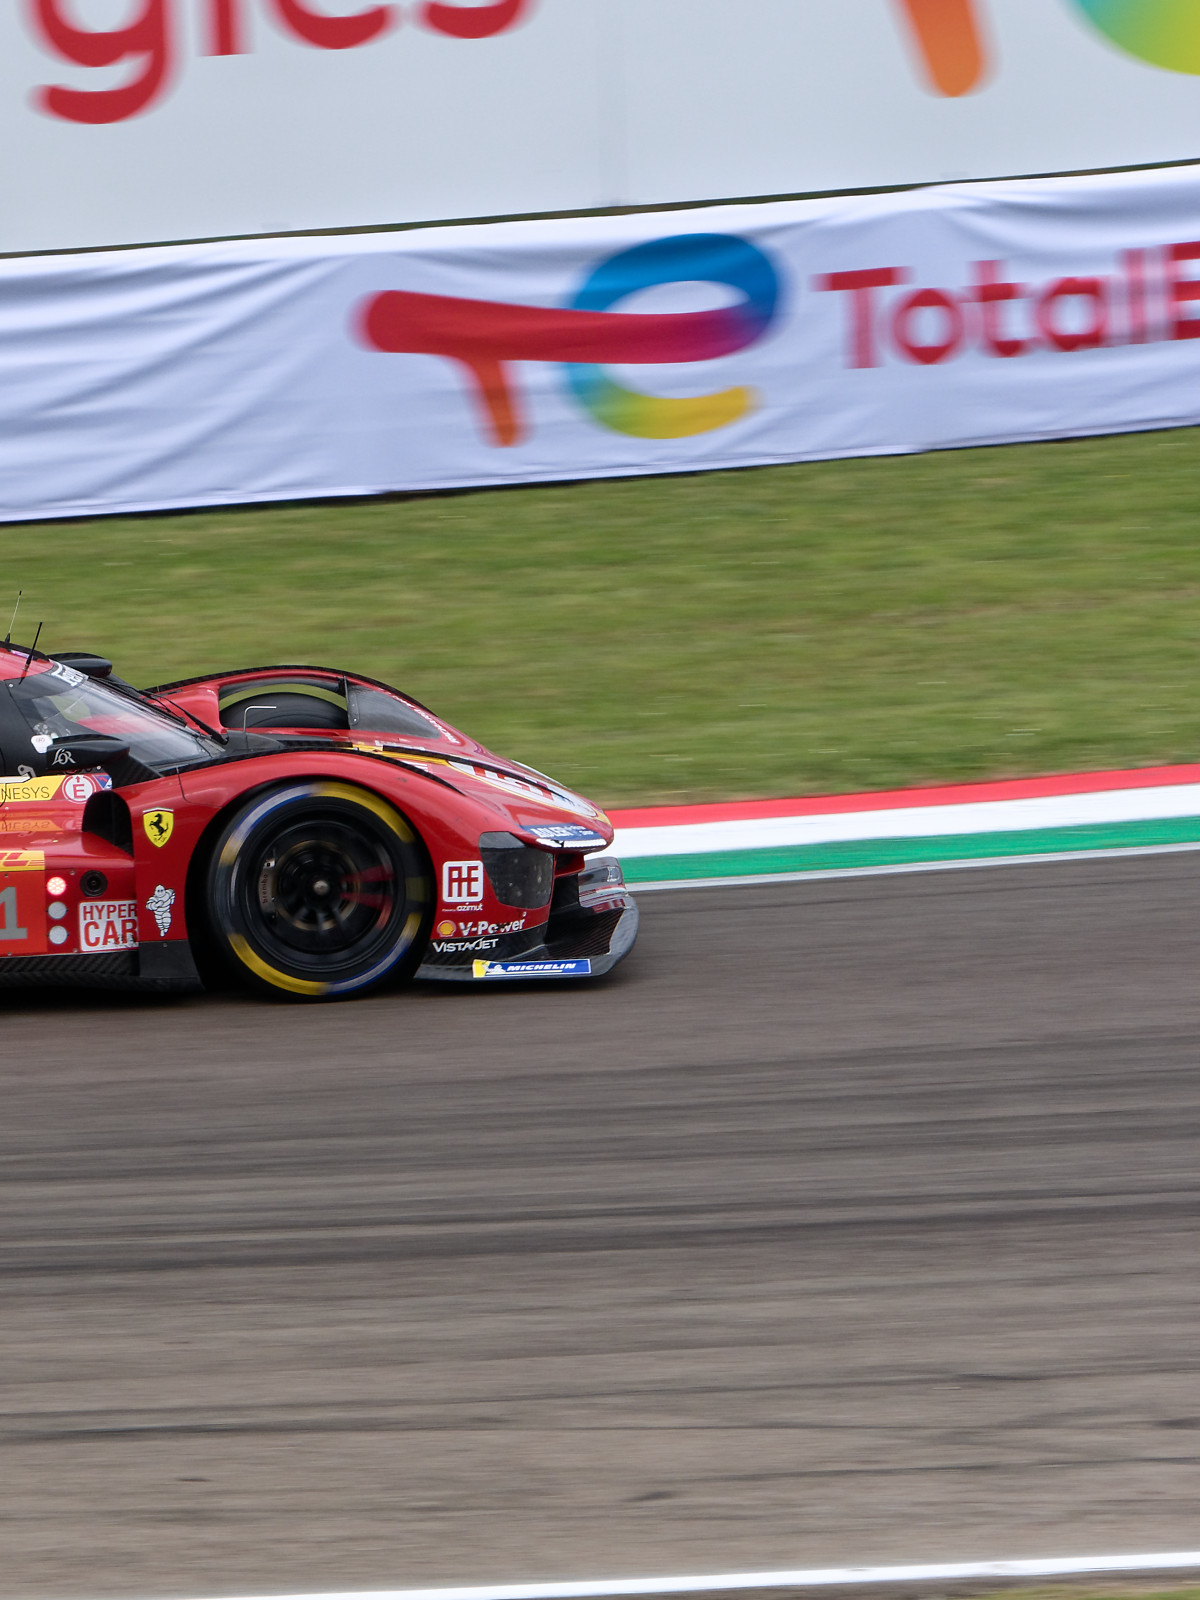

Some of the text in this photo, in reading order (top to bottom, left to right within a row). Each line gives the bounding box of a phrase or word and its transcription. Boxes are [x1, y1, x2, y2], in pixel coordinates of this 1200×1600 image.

[83, 903, 137, 921] HYPER
[456, 902, 483, 912] azimut
[84, 919, 138, 948] CAR
[458, 918, 526, 936] V-Power
[506, 962, 577, 972] MICHELIN
